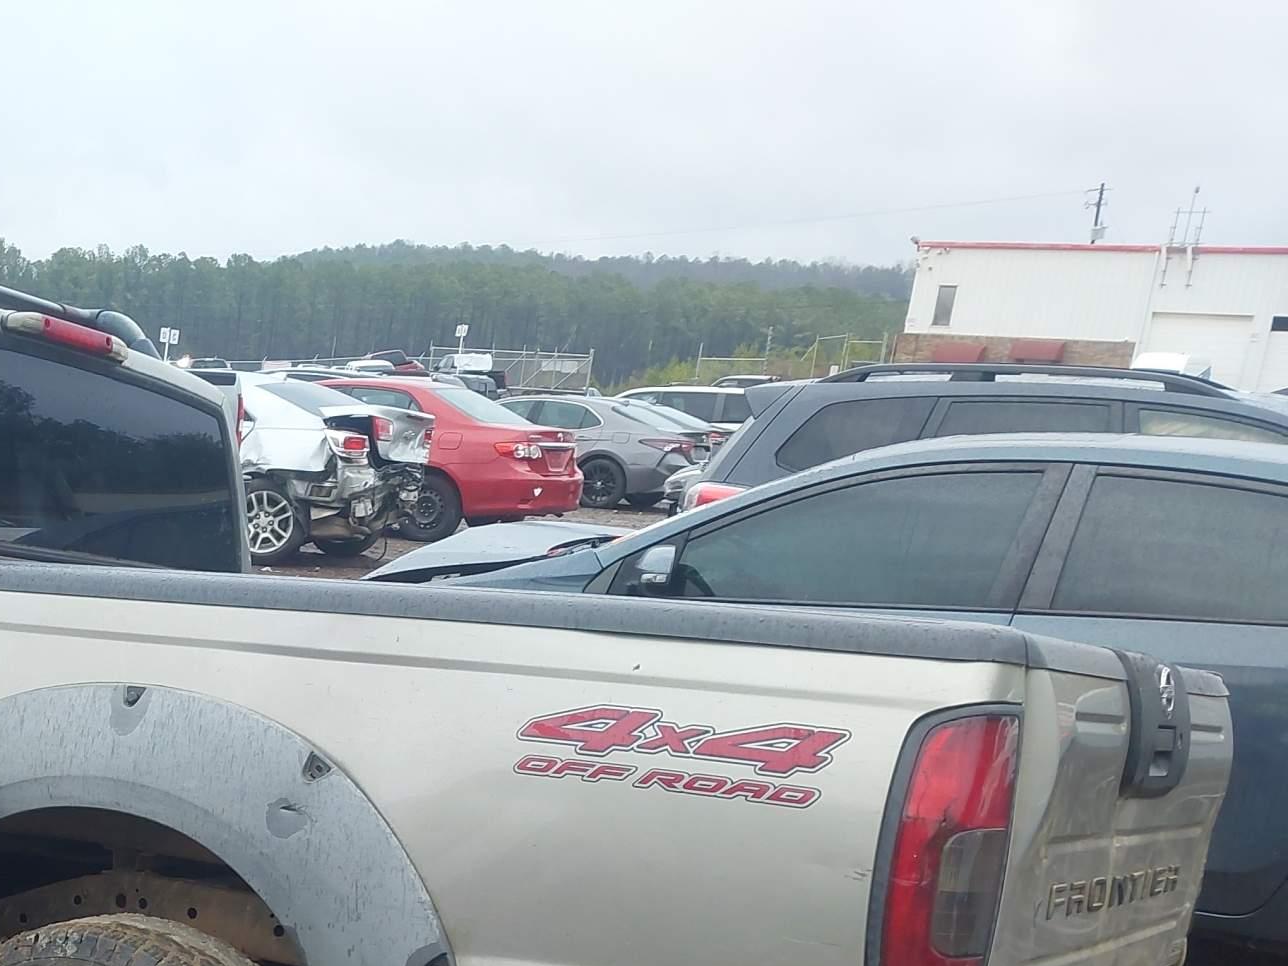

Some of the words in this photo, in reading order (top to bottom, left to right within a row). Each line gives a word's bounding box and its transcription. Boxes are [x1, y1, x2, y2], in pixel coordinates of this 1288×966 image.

[516, 704, 853, 778] 4x4
[514, 755, 638, 783] OFF
[632, 768, 822, 809] ROAD
[1046, 865, 1180, 921] FRONTIER
